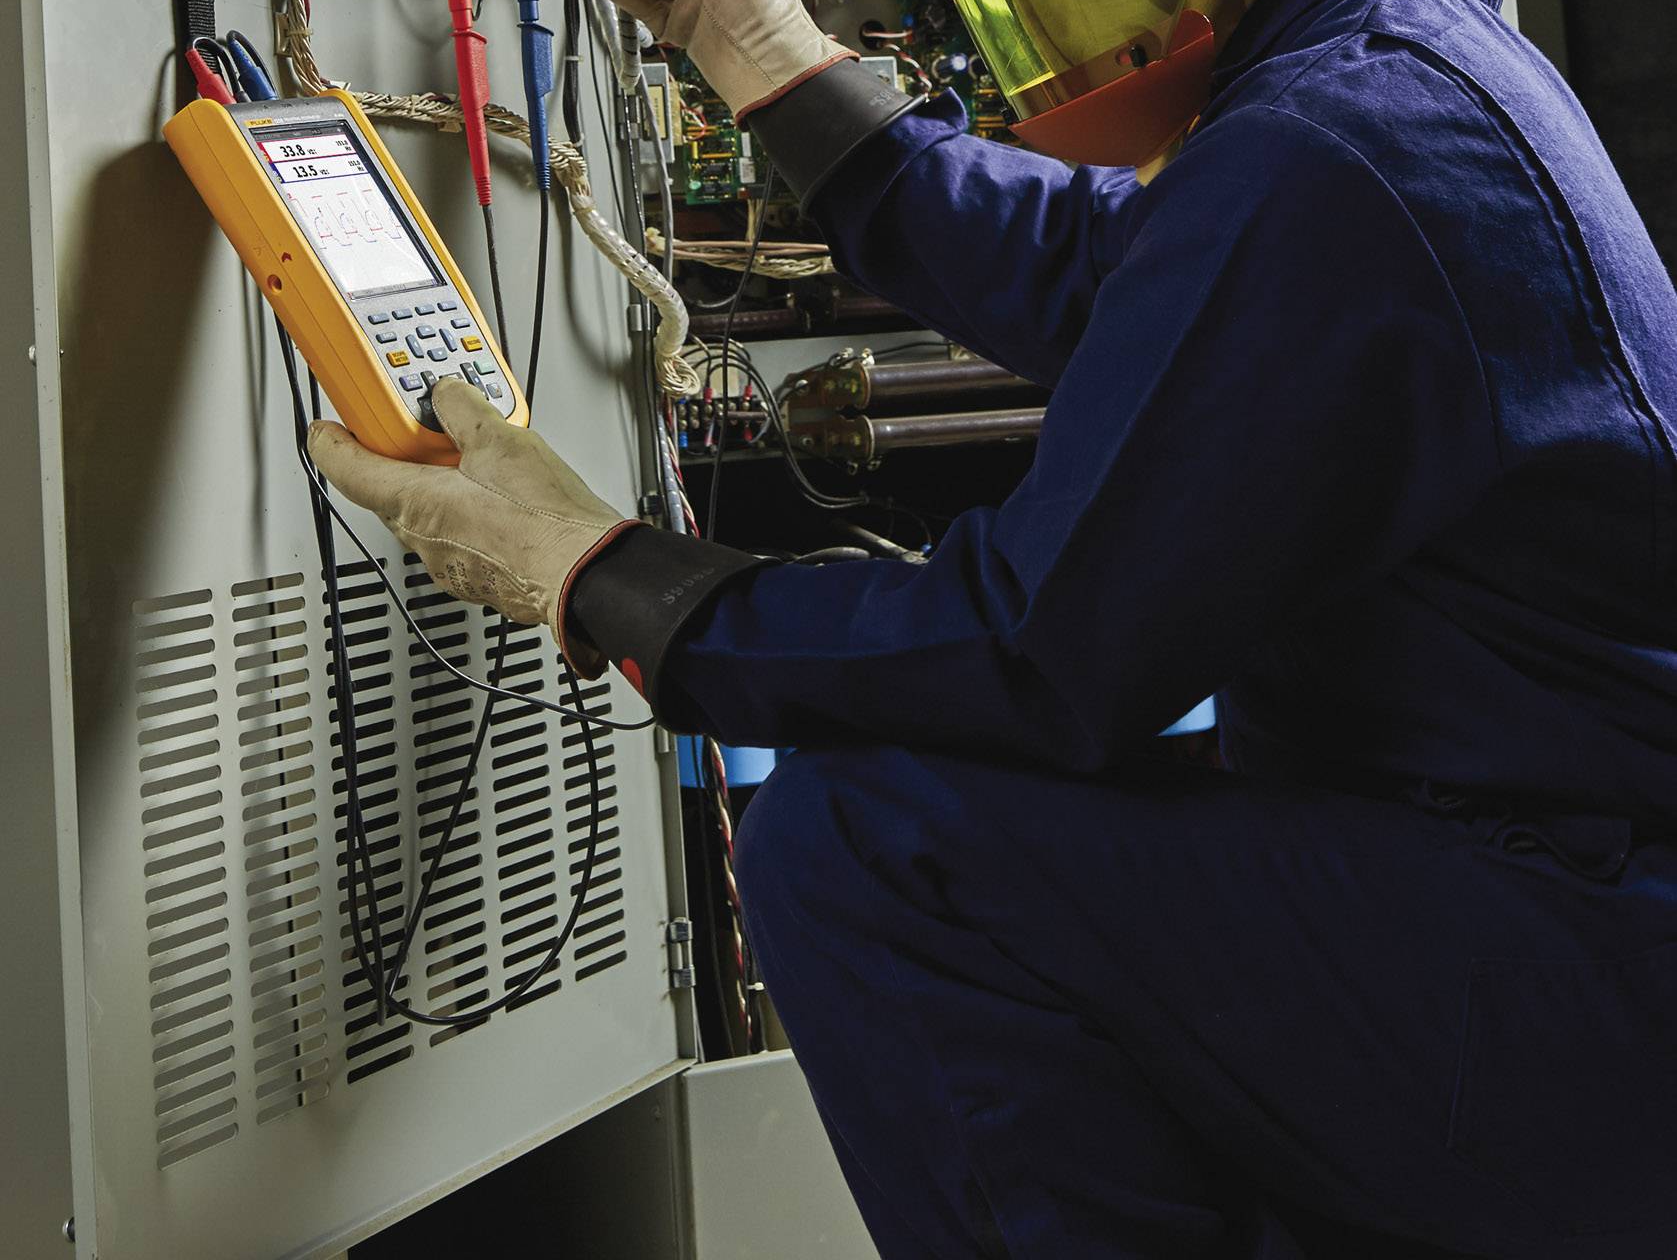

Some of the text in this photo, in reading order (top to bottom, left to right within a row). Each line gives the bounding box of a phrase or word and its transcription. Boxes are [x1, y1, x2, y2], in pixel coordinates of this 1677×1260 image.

[250, 118, 272, 126] FLUKE
[280, 145, 305, 158] 33.8
[293, 165, 318, 178] 13.5
